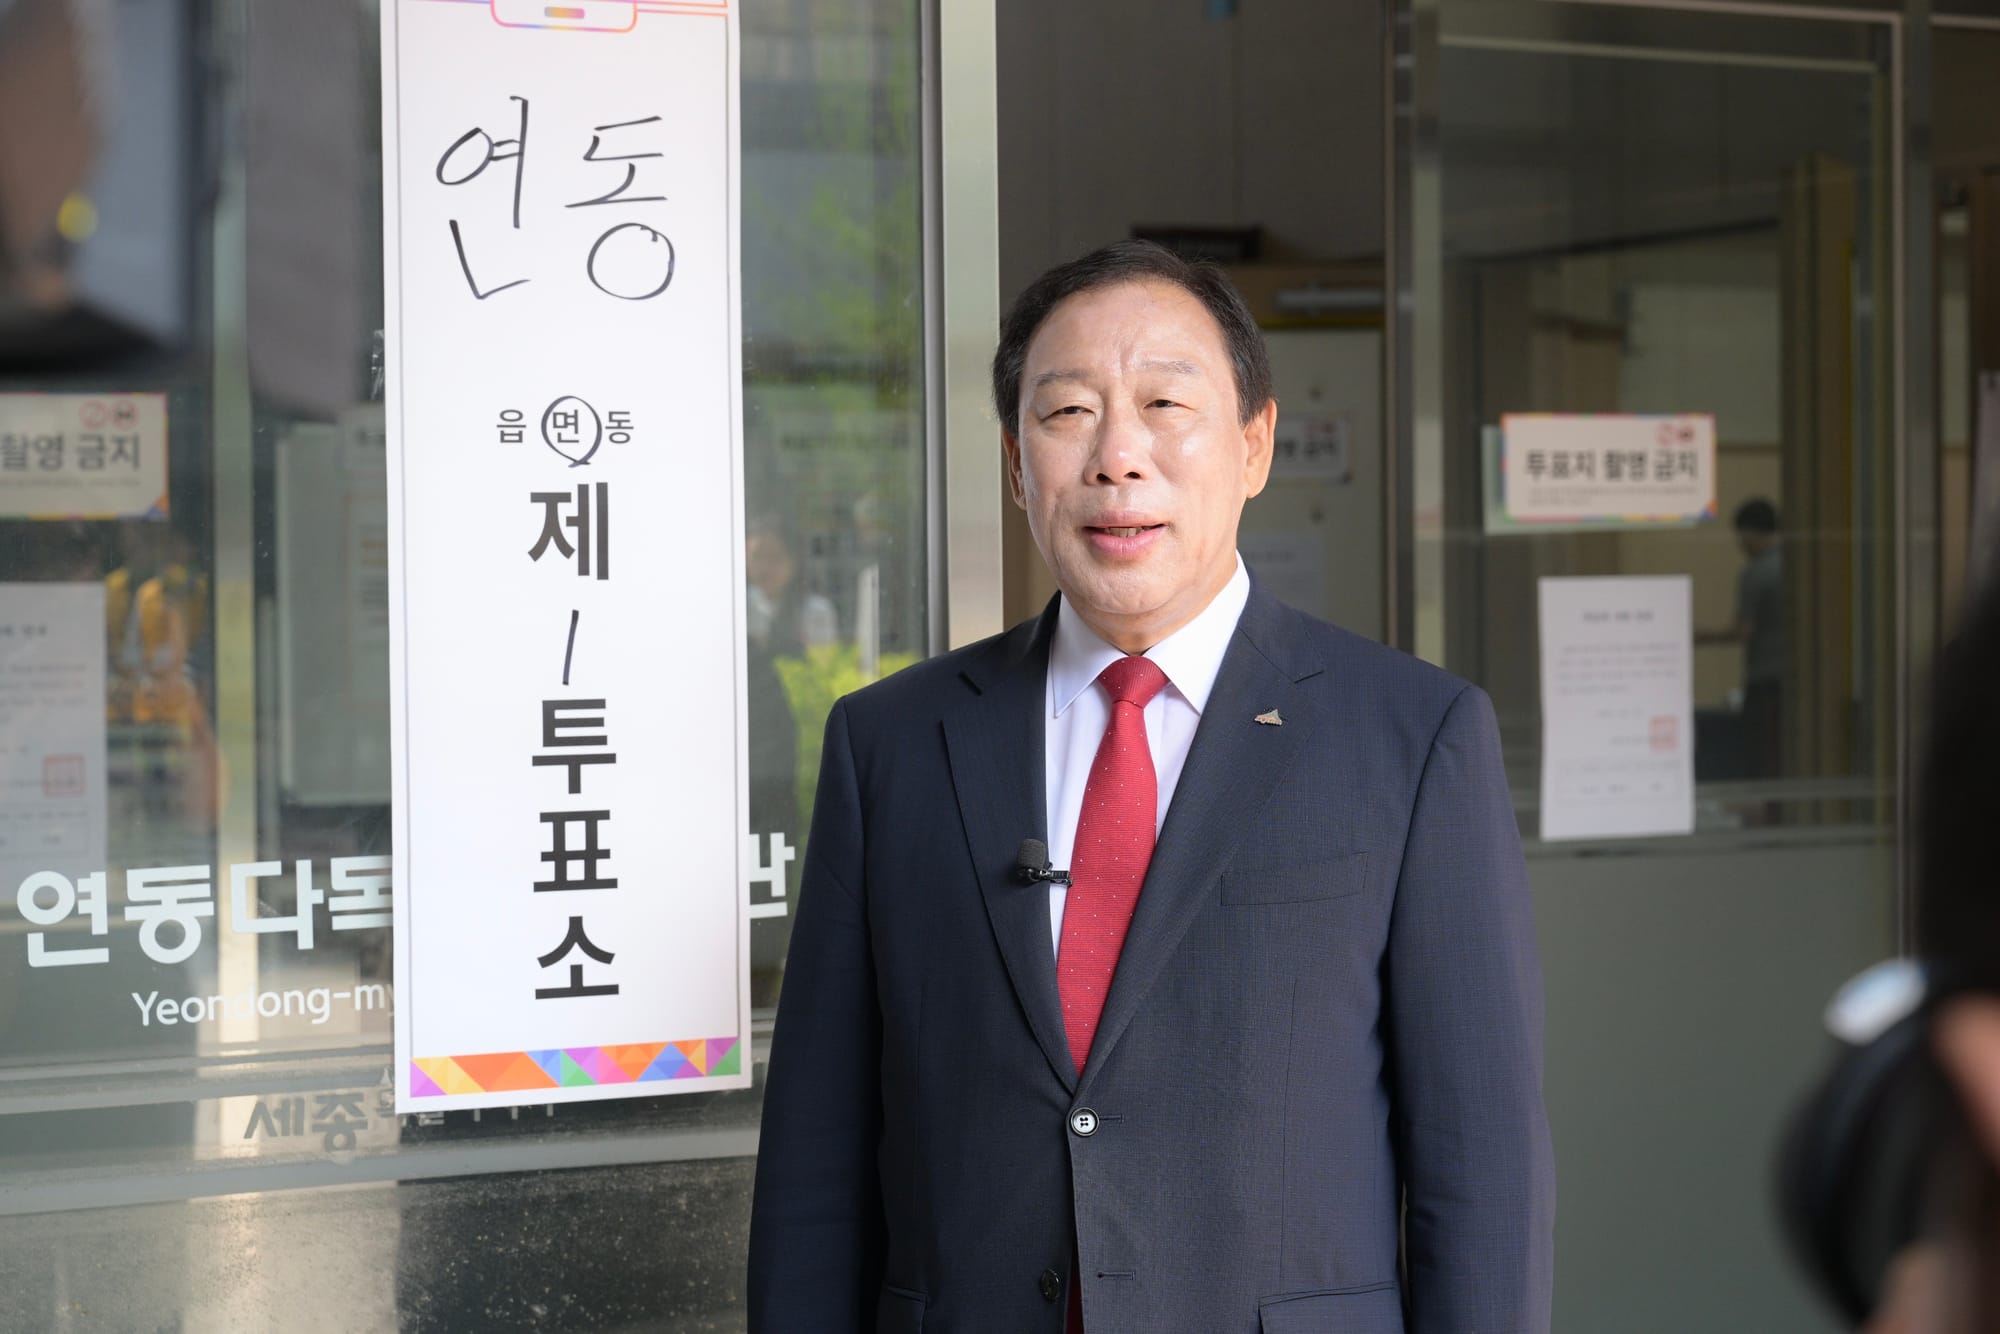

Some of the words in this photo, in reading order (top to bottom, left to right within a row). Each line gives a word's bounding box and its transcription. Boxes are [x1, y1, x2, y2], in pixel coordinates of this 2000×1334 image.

[436, 95, 675, 300] 연동
[77, 433, 140, 471] 금지
[1527, 450, 1596, 480] 투표지
[1655, 449, 1698, 481] 금지
